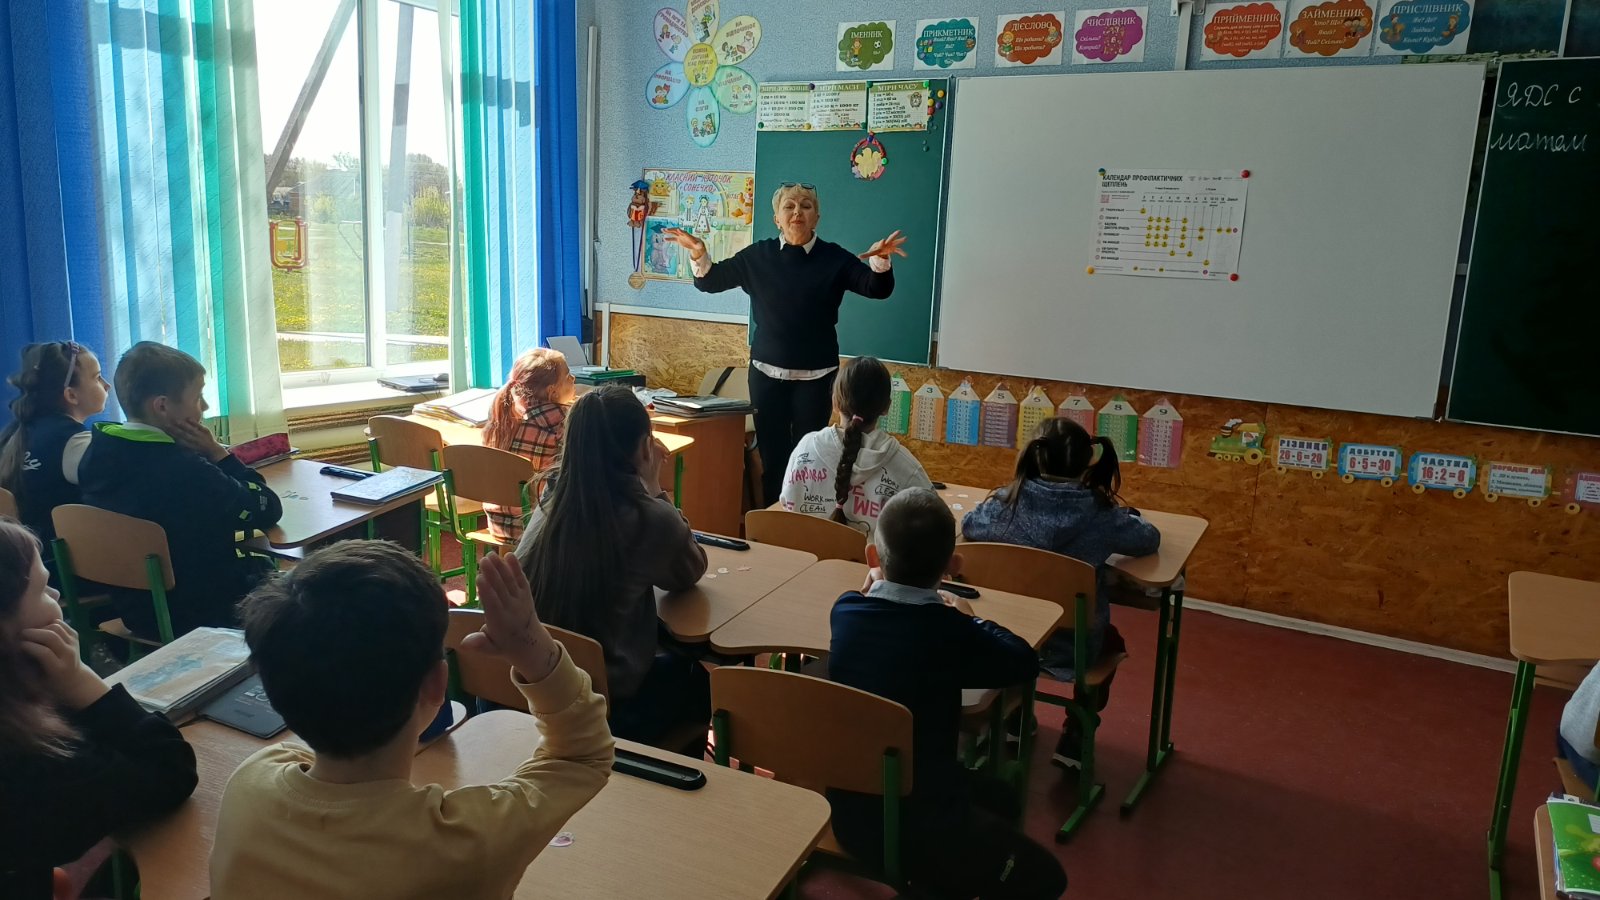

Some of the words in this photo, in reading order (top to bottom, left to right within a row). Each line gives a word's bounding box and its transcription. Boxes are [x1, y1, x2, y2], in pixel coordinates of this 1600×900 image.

[1393, 3, 1463, 14] ПРИСЛІВНИК
[1302, 8, 1365, 19] ЗАЙМЕННИК
[1087, 17, 1136, 26] ЧИСЛІВНИК
[1213, 13, 1280, 24] ПРИЙМЕННИК
[1011, 21, 1053, 31] ДІЄСЛОВО
[851, 30, 883, 38] ІМЕННИК
[923, 28, 974, 38] ПРИКМЕТНИК
[877, 84, 897, 92] МІРИ
[1102, 174, 1131, 182] КАЛЕНДАР
[1132, 174, 1184, 182] ПРОФІЛАКТИЧНИХ
[997, 392, 1005, 400] 5
[1114, 403, 1122, 411] 8
[1159, 408, 1168, 416] 9
[1421, 457, 1469, 469] ЧАСТКА
[804, 492, 824, 503] WORK
[800, 503, 826, 512] CLEAN
